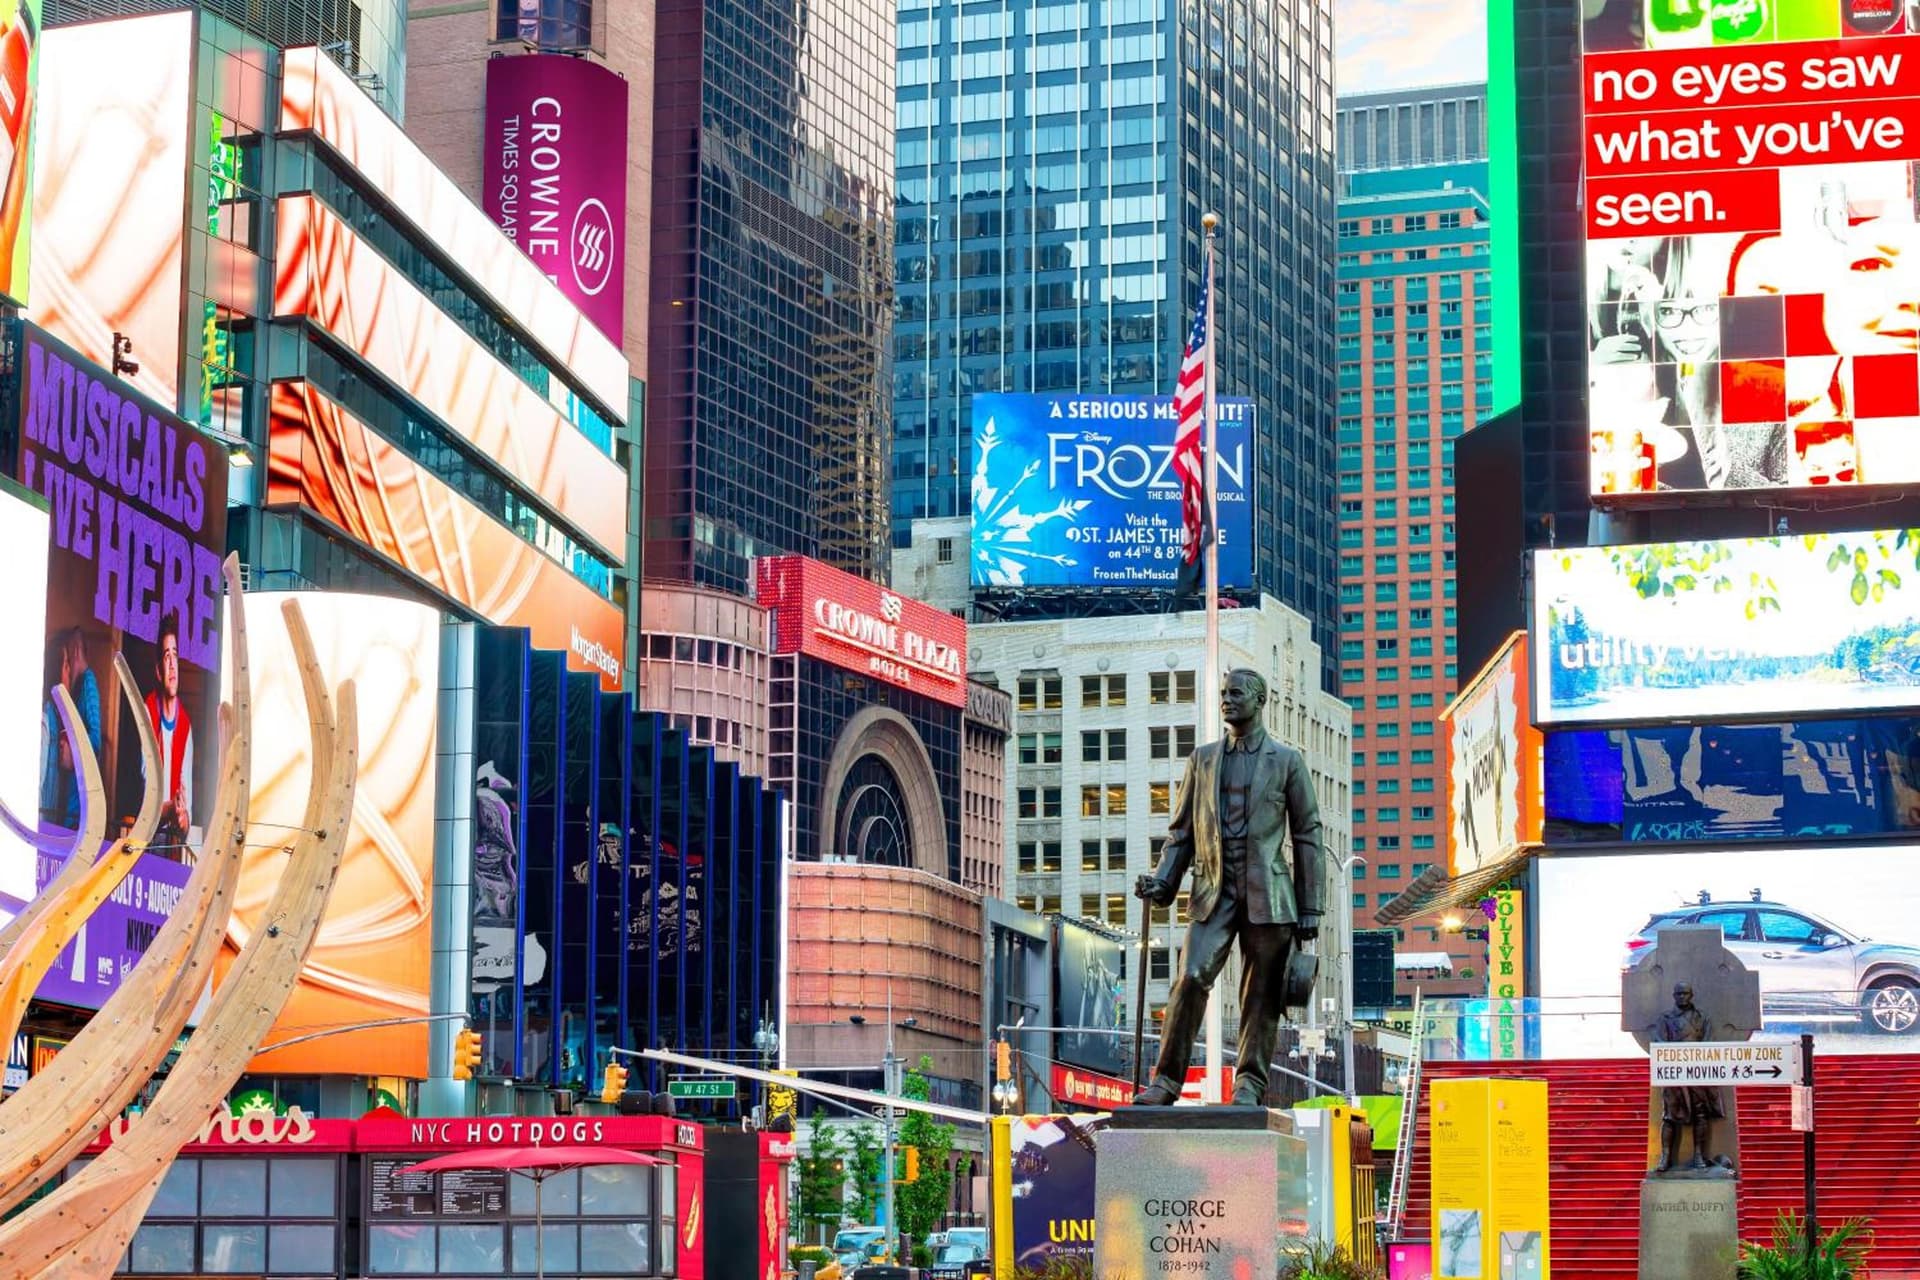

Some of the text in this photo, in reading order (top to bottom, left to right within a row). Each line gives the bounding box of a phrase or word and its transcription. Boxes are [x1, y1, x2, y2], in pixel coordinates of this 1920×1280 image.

[1593, 53, 1901, 104] no eyes saw
[1593, 120, 1721, 164] what
[500, 115, 519, 248] TIMES SQUAR
[529, 97, 562, 256] CROWNE
[1594, 187, 1726, 227] seen.
[1069, 401, 1148, 419] SERIOUS
[25, 341, 206, 532] MUSICALS
[1047, 432, 1244, 499] FROZN
[1147, 491, 1162, 501] THE
[1217, 492, 1245, 501] USICAL
[1125, 513, 1167, 526] Visit the
[1082, 527, 1101, 543] ST.
[1106, 528, 1155, 544] JAMES
[1108, 550, 1120, 559] on
[1153, 547, 1163, 559] &
[94, 490, 221, 674] HERE
[814, 598, 961, 676] CROWNE PLAZA
[869, 656, 911, 683] HOTEL
[1498, 902, 1514, 975] OLIVE
[1657, 1047, 1783, 1062] PEDESTRIAN FLOW ZONE
[1657, 1065, 1726, 1079] KEEP MOVING
[684, 1085, 692, 1095] W
[695, 1085, 706, 1095] 47
[412, 1122, 604, 1143] NYC HOTDOGS
[1144, 1199, 1225, 1218] GEORGE
[1150, 1236, 1221, 1253] COHAN
[1159, 1260, 1211, 1274] 1878-1942
